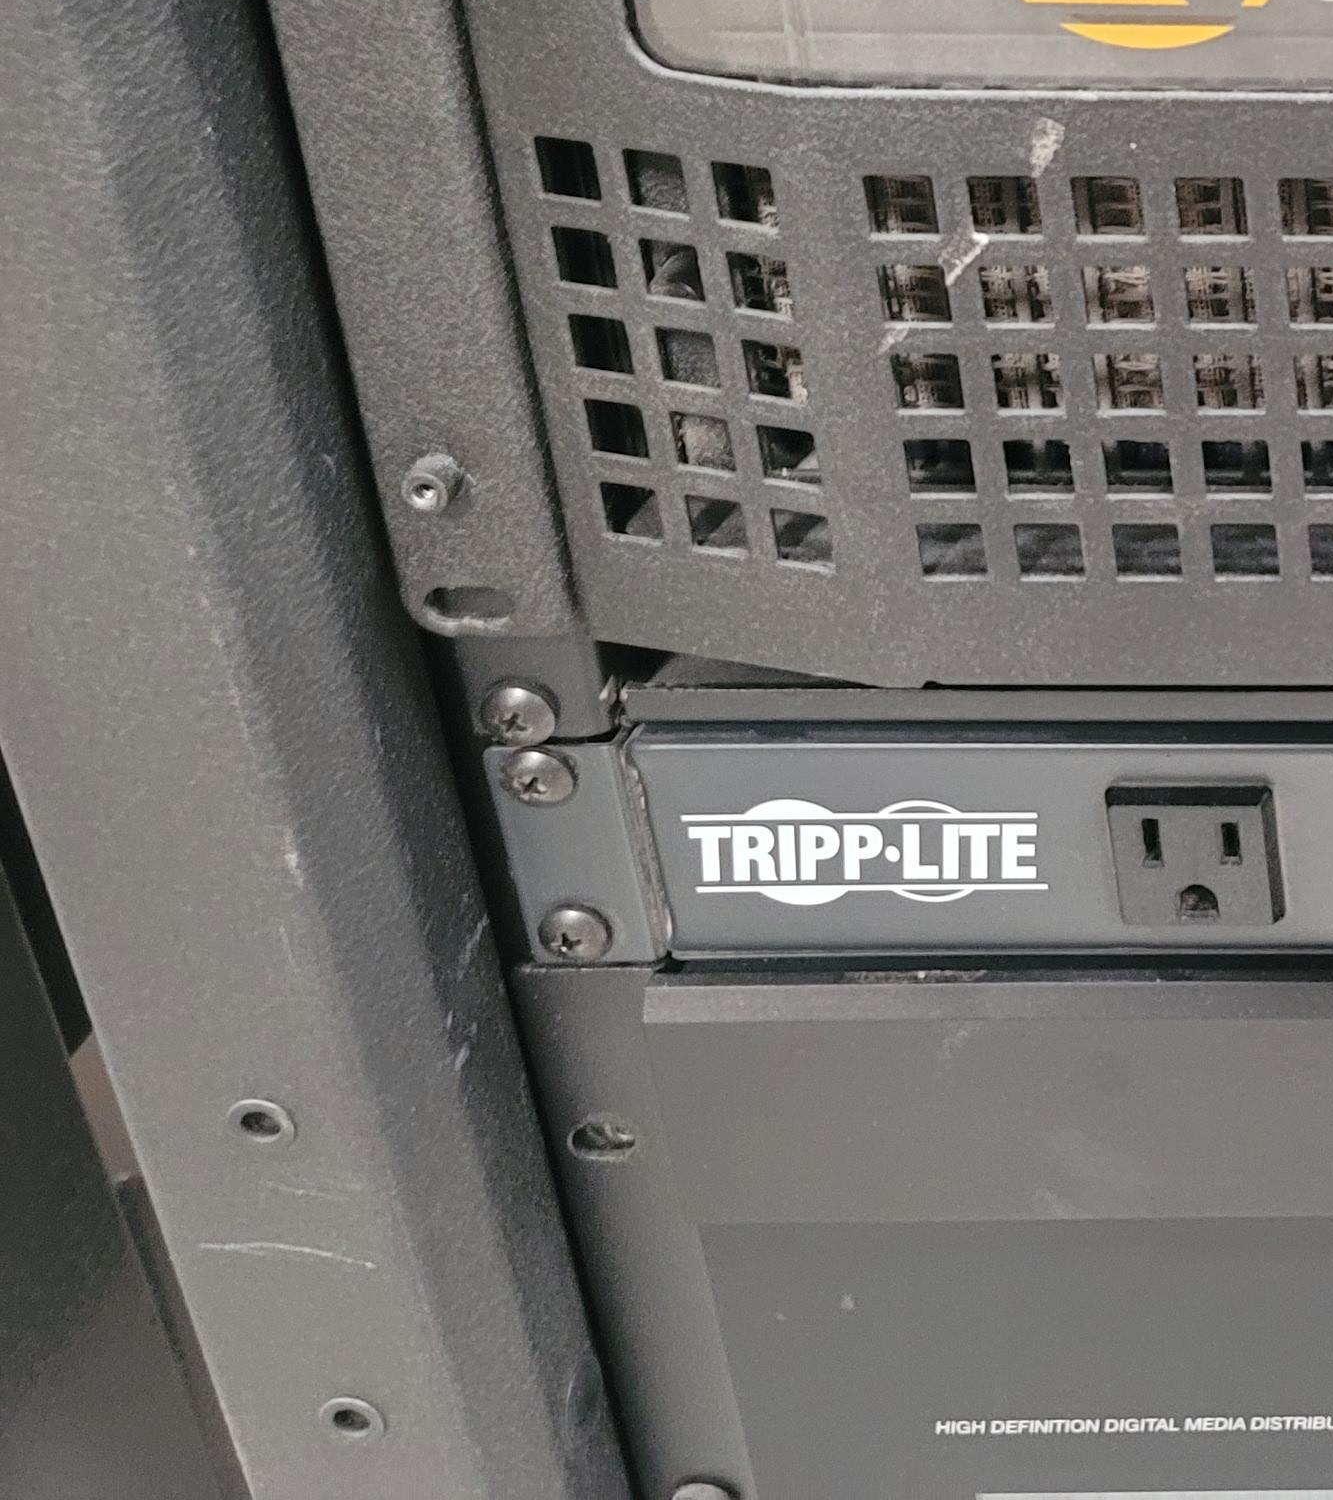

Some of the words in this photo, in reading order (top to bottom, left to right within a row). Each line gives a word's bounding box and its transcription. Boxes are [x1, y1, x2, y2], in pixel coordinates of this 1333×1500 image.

[935, 1419, 987, 1436] HIGH
[990, 1418, 1102, 1435] DEFINITION
[1103, 1417, 1181, 1434] DIGITAL
[1184, 1416, 1247, 1433] MEDIA
